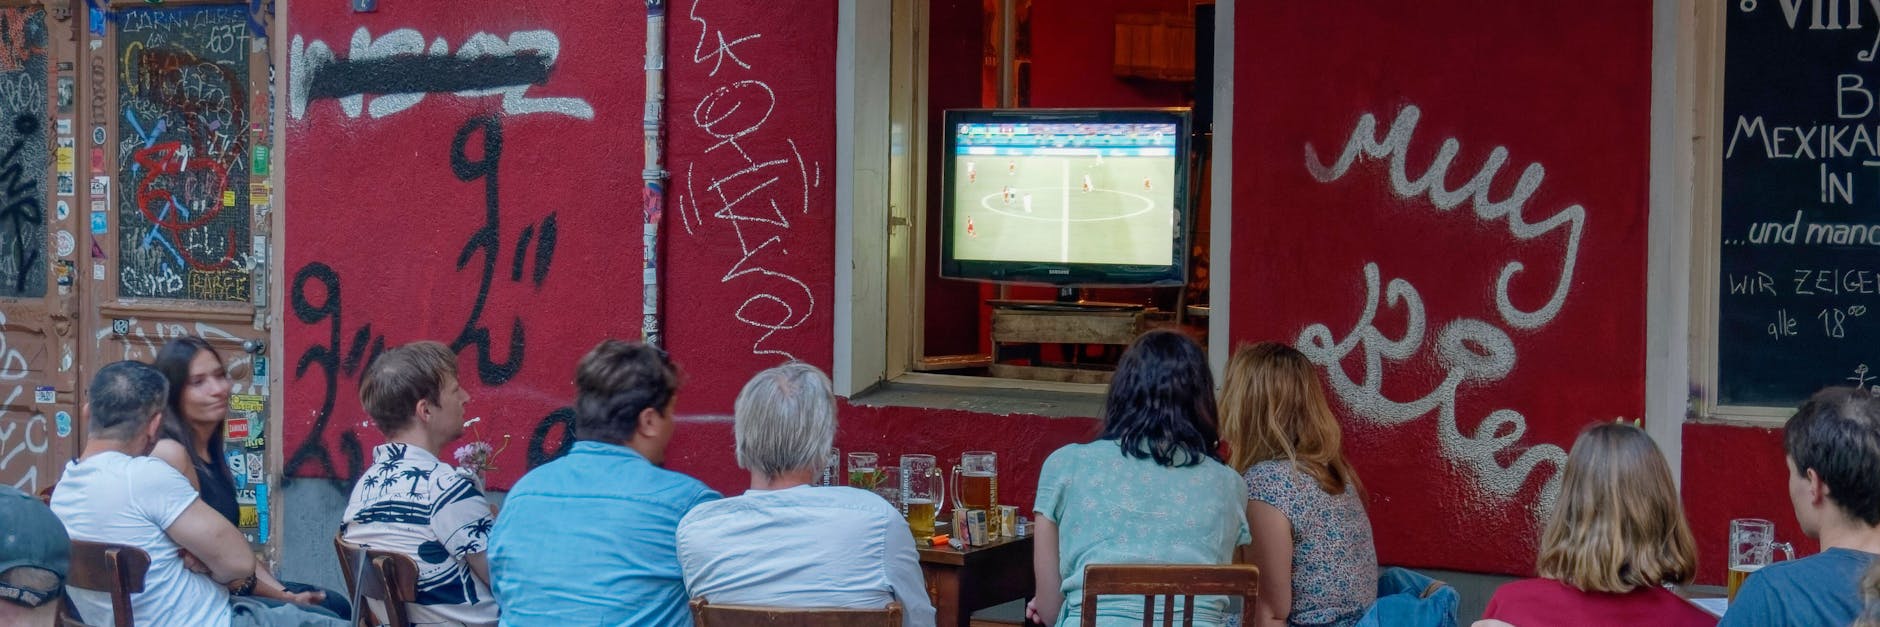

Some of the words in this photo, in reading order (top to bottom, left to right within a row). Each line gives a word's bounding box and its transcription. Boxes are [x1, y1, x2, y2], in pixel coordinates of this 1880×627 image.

[206, 22, 250, 60] 637
[1820, 163, 1853, 204] IN
[1730, 271, 1777, 296] WIR
[1768, 308, 1798, 341] alle
